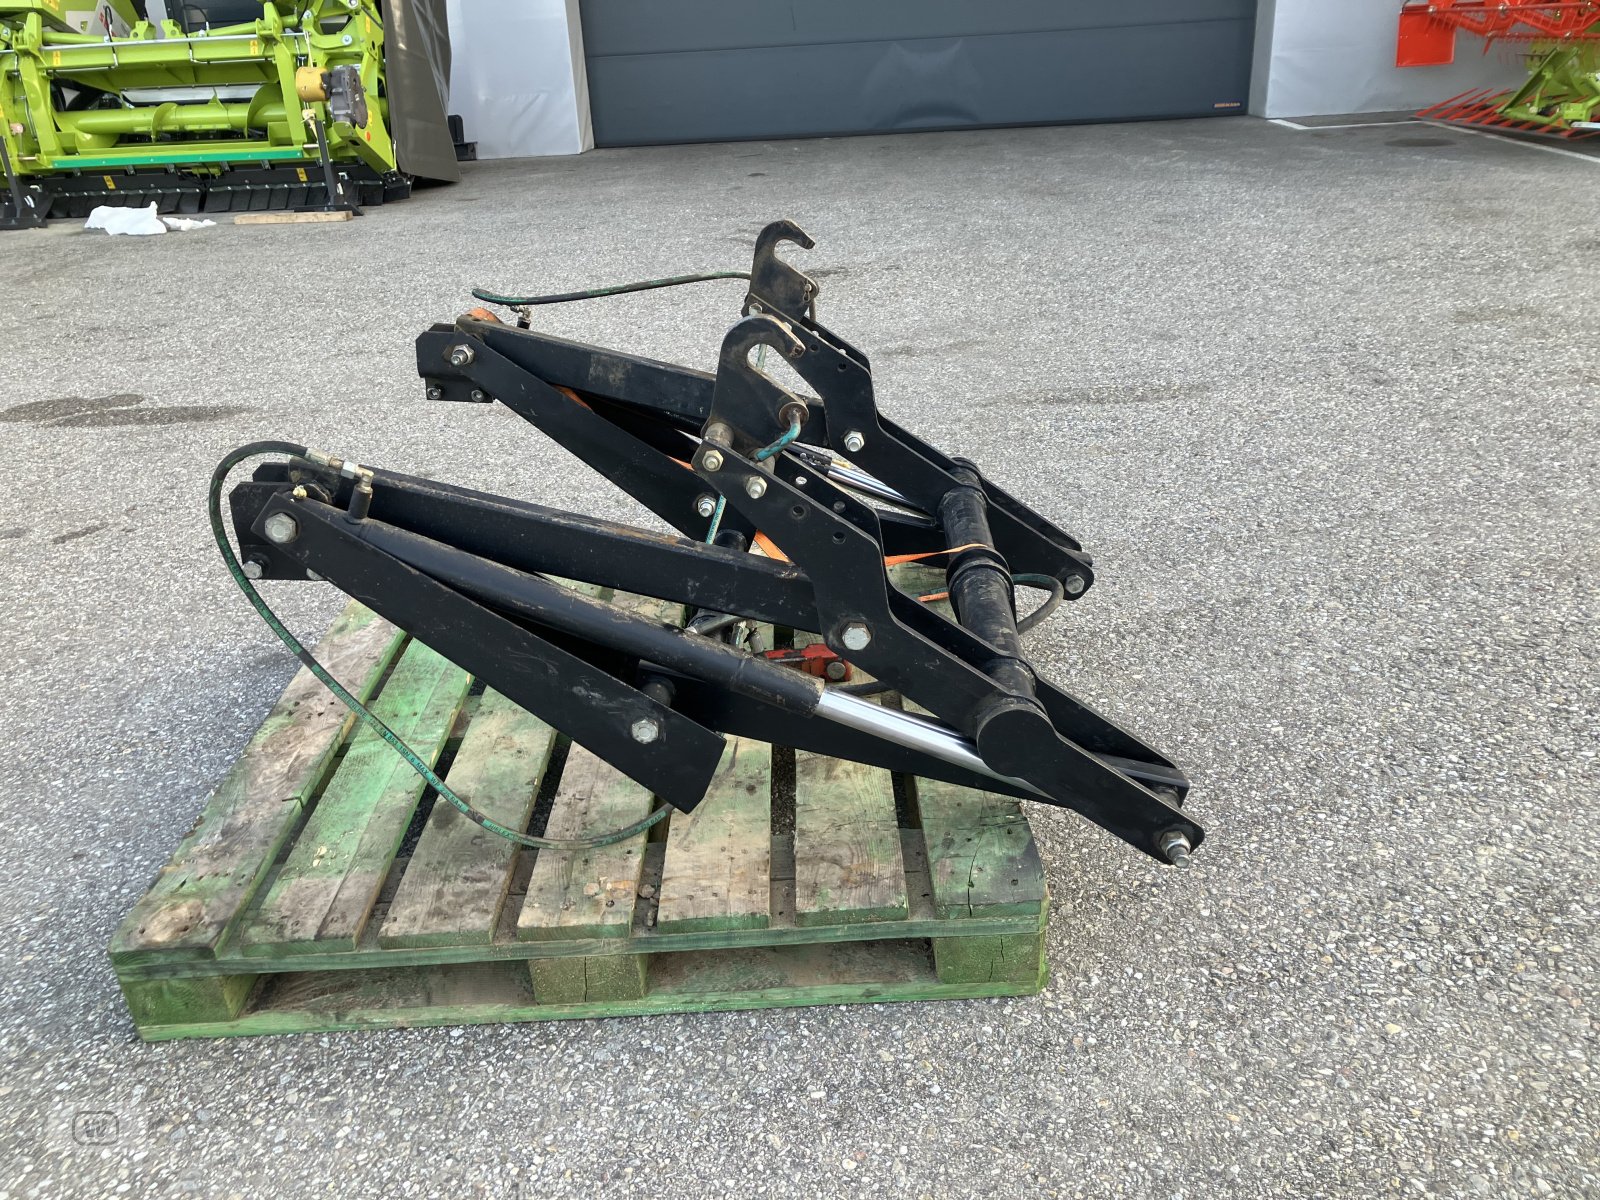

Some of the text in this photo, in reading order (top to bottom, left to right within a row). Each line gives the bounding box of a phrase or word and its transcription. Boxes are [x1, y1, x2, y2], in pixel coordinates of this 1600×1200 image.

[266, 614, 277, 626] WP
[285, 635, 298, 648] BAR
[337, 688, 369, 717] GREENLINE
[388, 735, 399, 745] 853
[399, 745, 411, 756] 1SN
[416, 762, 430, 775] MAX
[431, 777, 441, 787] WP
